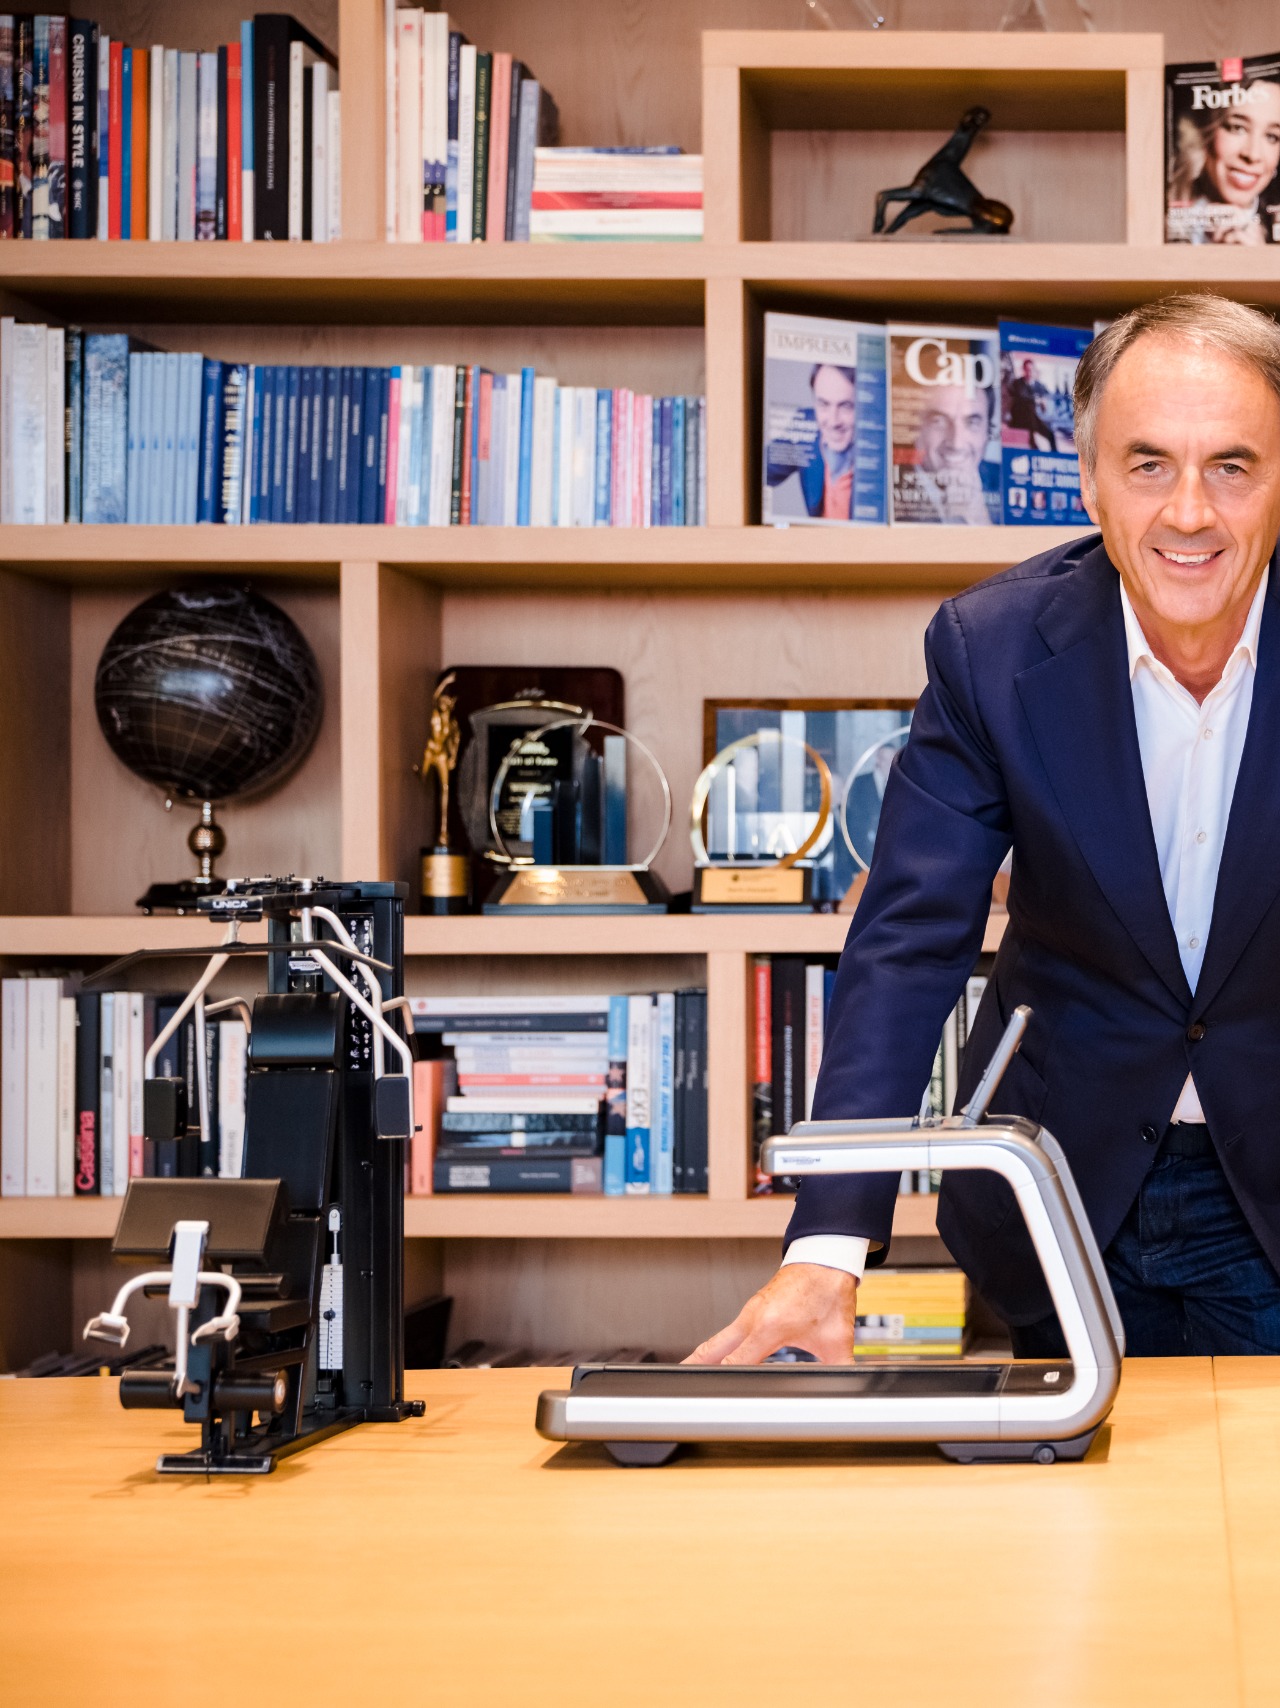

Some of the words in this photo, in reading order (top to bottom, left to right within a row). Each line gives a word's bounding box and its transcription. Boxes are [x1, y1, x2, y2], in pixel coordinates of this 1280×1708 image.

[71, 34, 85, 102] CRUISING
[71, 106, 85, 122] IN
[71, 124, 85, 168] STYLE
[212, 900, 248, 909] UNICA
